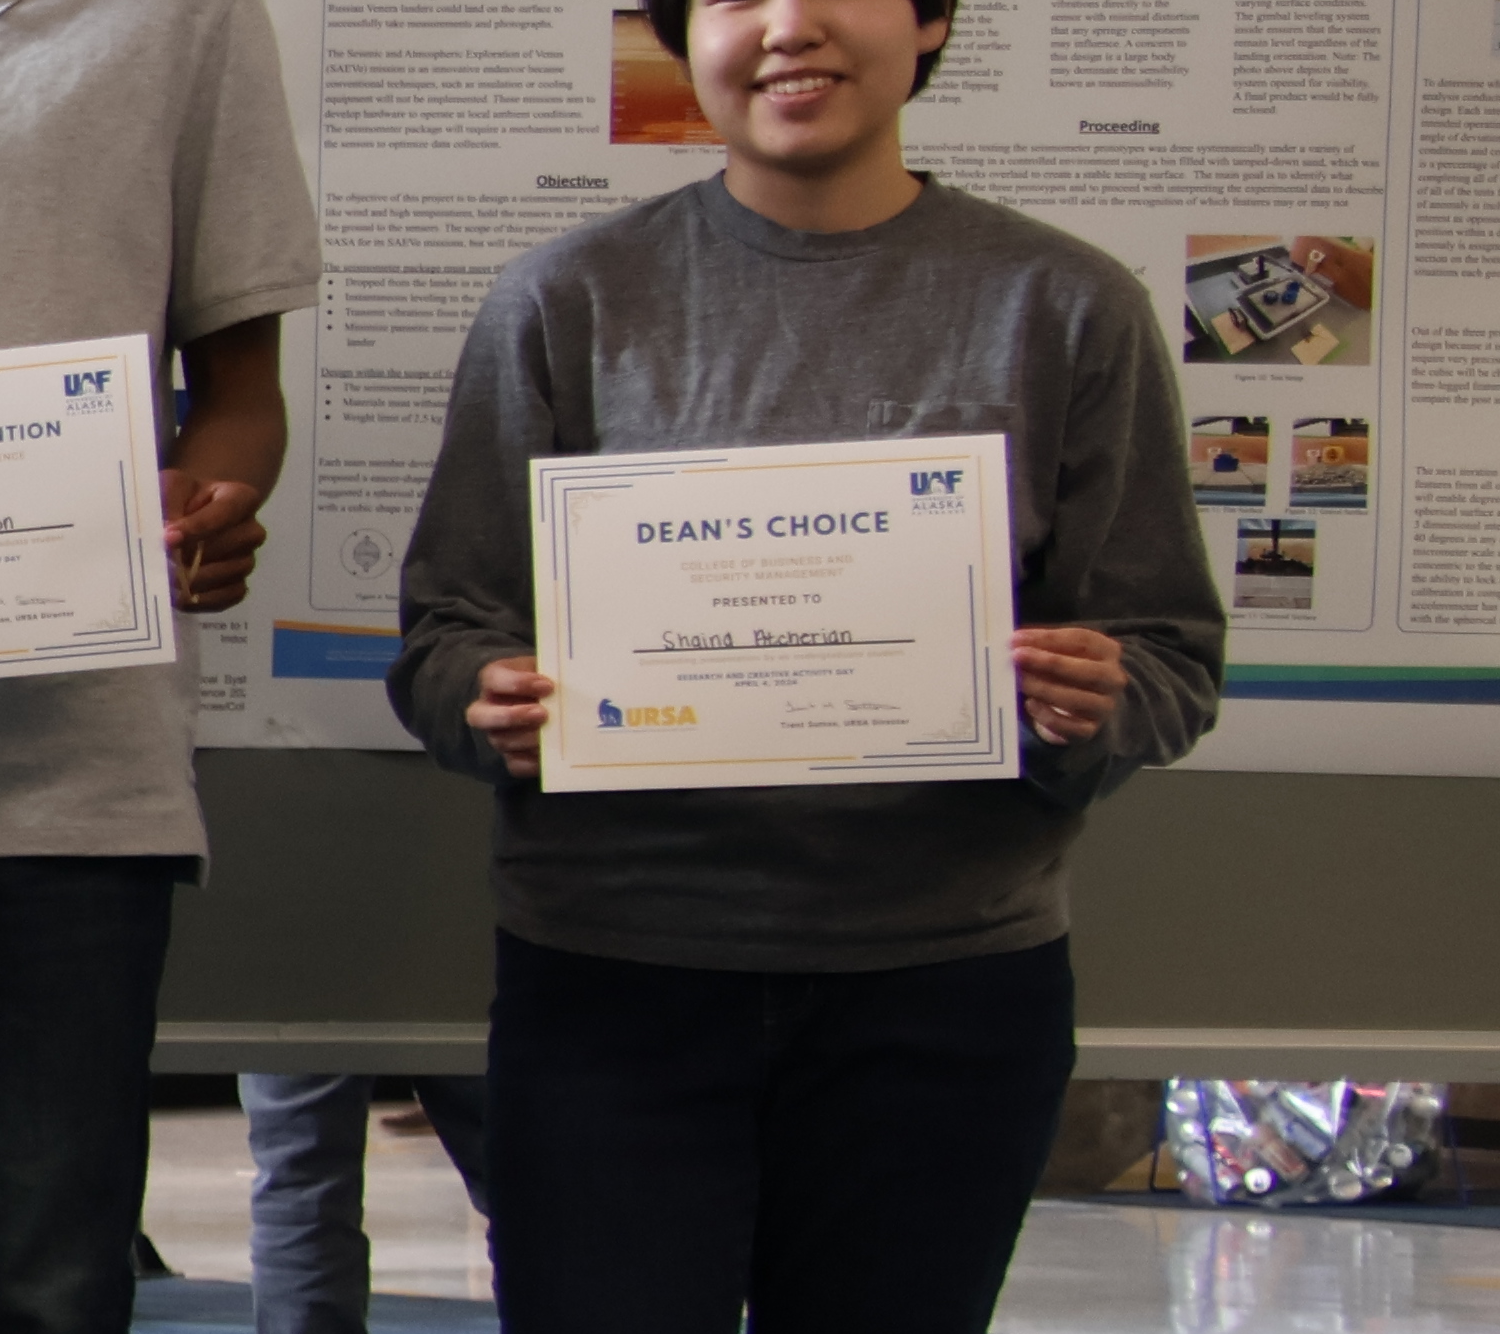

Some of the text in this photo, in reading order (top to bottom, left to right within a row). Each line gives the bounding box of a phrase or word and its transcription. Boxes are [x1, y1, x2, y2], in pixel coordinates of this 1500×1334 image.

[1079, 120, 1160, 134] Proceeding
[536, 175, 609, 189] Objectives
[64, 371, 110, 396] UAF
[911, 471, 962, 495] UAF
[637, 511, 889, 543] DEAN'S CHOICE
[713, 593, 821, 607] PRESENTED TO
[662, 629, 734, 649] Shaina
[627, 705, 696, 727] URSA
